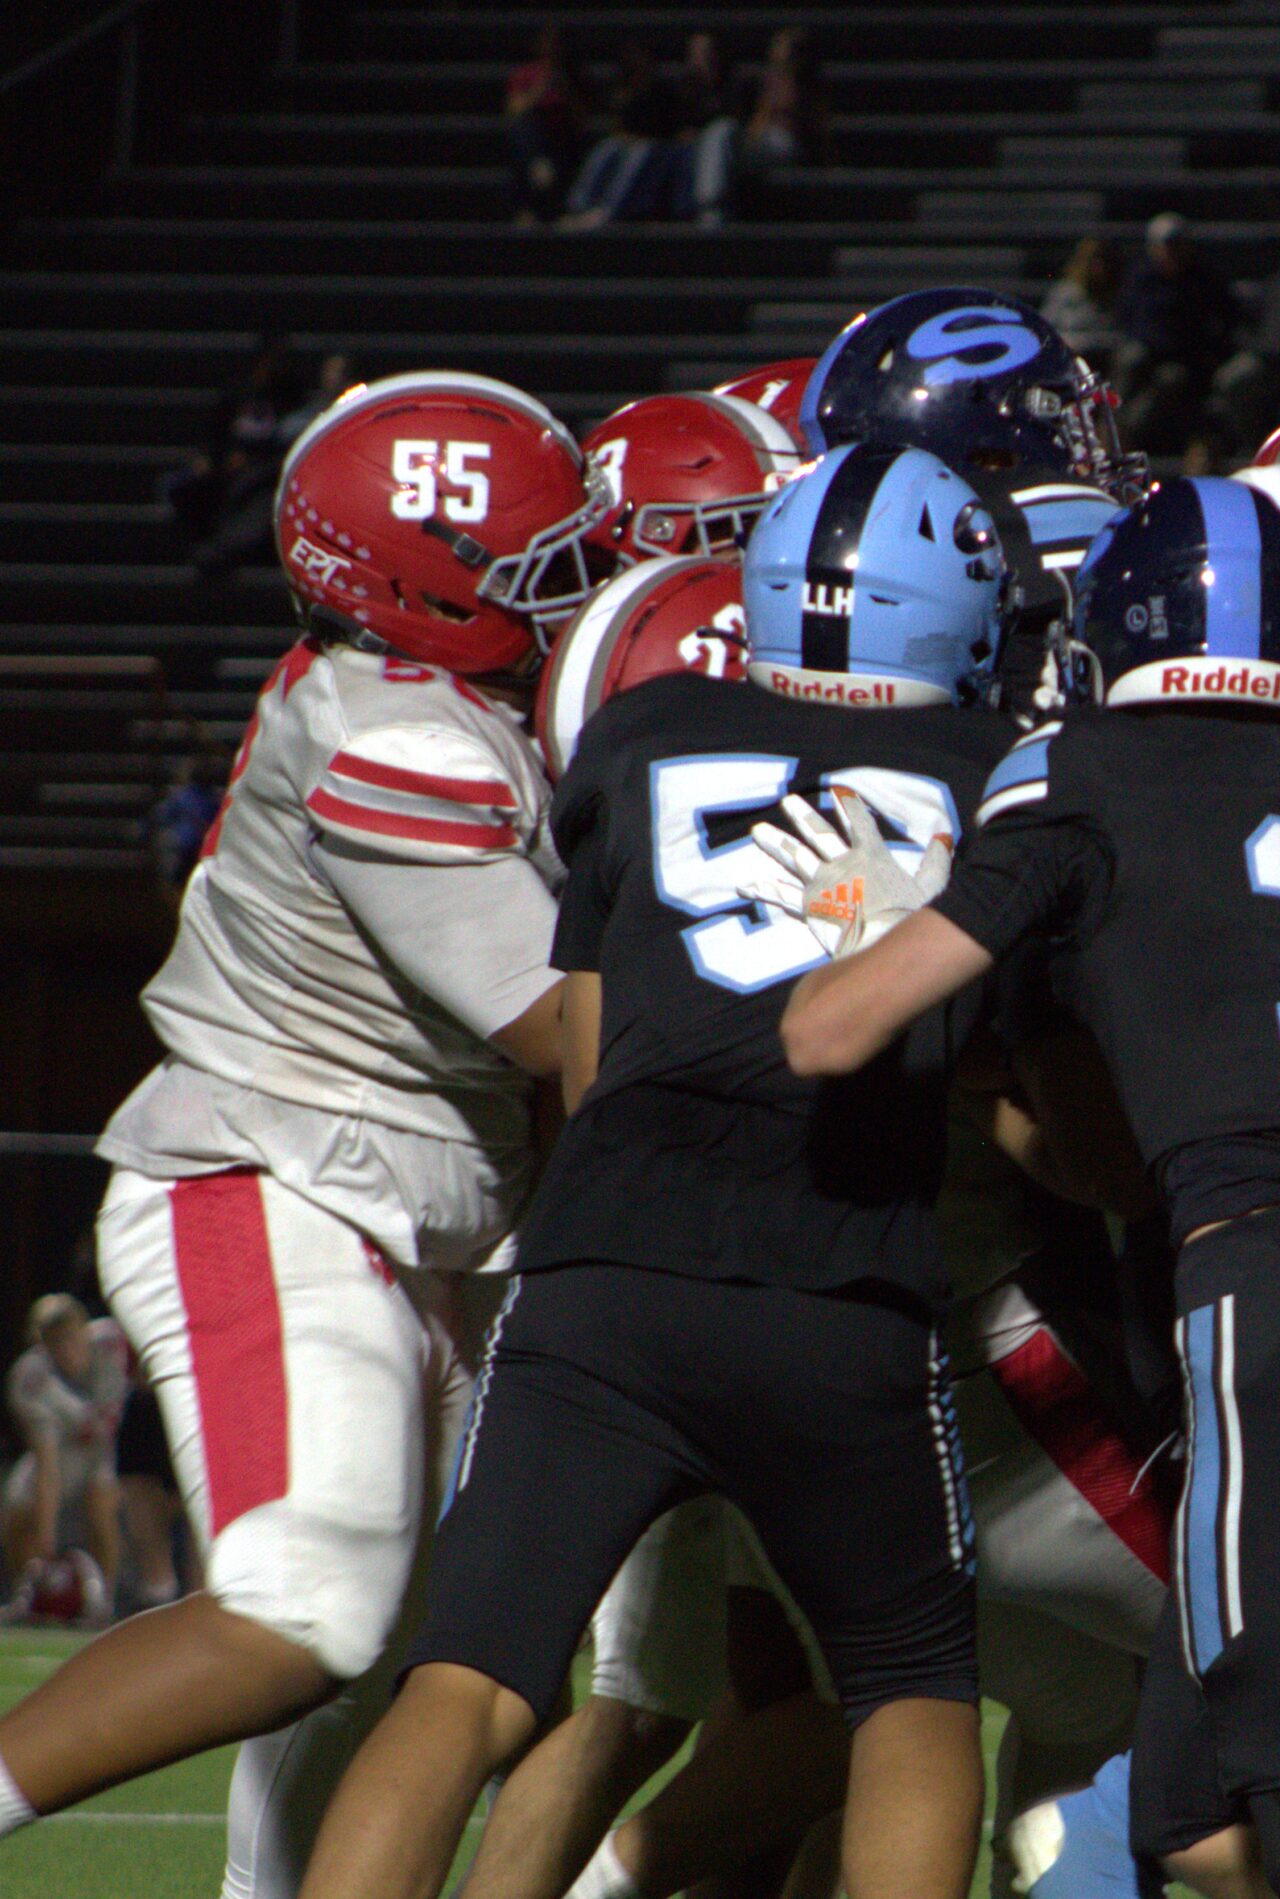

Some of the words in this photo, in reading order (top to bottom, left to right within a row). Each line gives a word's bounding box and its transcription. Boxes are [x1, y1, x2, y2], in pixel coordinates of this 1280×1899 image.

[907, 306, 1041, 386] S
[391, 439, 490, 523] 55
[802, 582, 856, 616] LLH
[771, 670, 895, 706] Riddell
